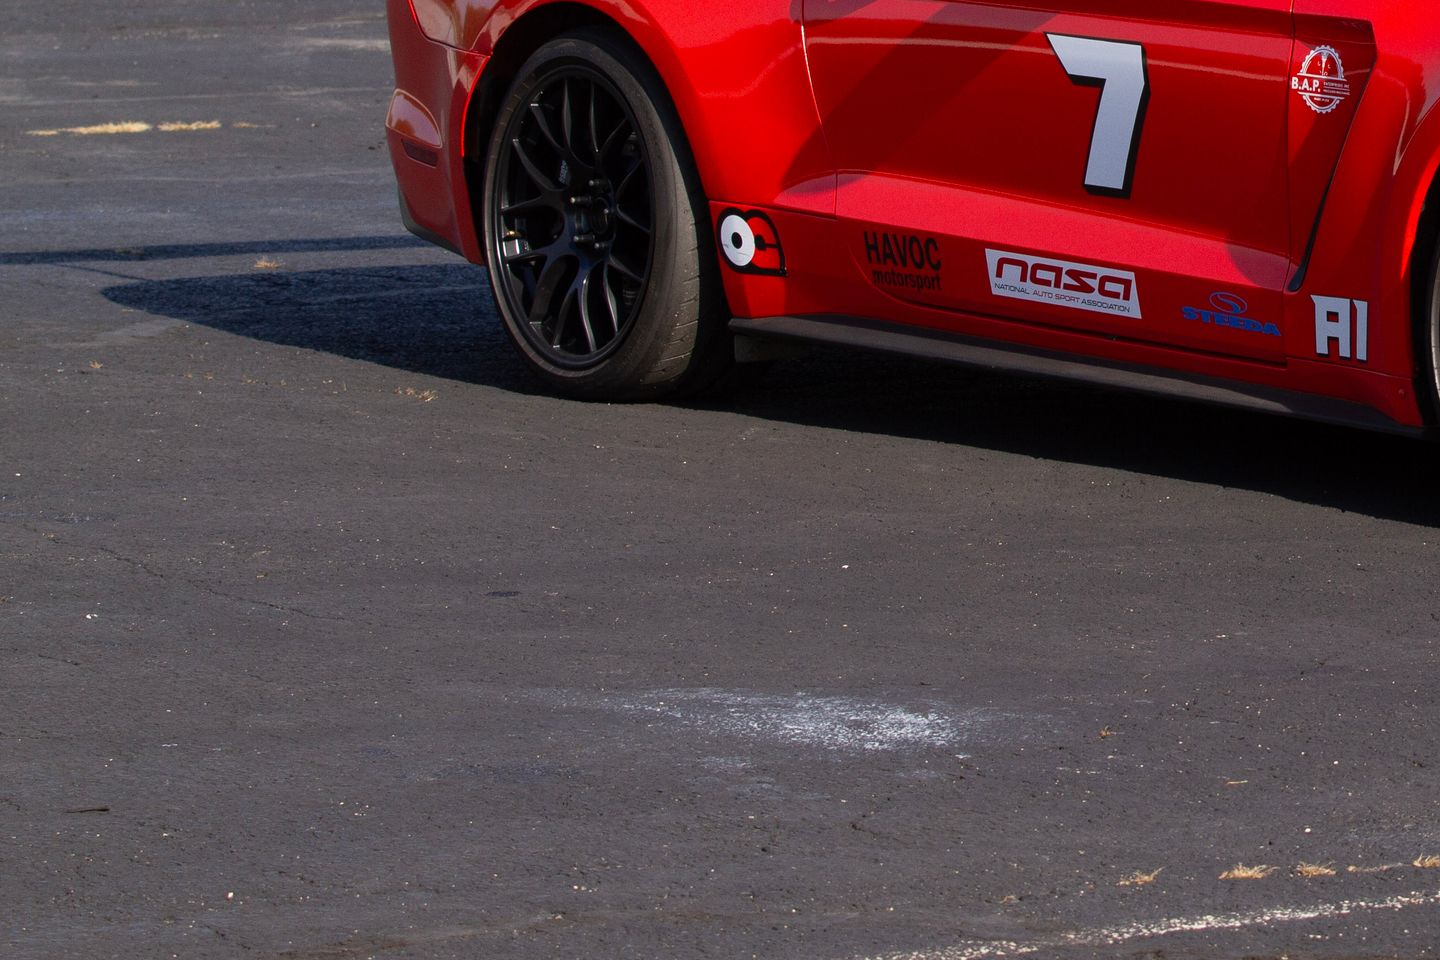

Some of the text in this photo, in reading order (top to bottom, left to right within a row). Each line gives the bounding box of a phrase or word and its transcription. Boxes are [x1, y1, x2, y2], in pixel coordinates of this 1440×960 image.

[1291, 76, 1321, 93] B.A.P.
[1043, 31, 1151, 200] 7
[864, 231, 941, 270] HAVOC
[872, 268, 943, 292] motorsport
[994, 283, 1131, 313] NATIONAL AUTO SPORT ASSOCIATION
[1181, 306, 1281, 337] STEEDA
